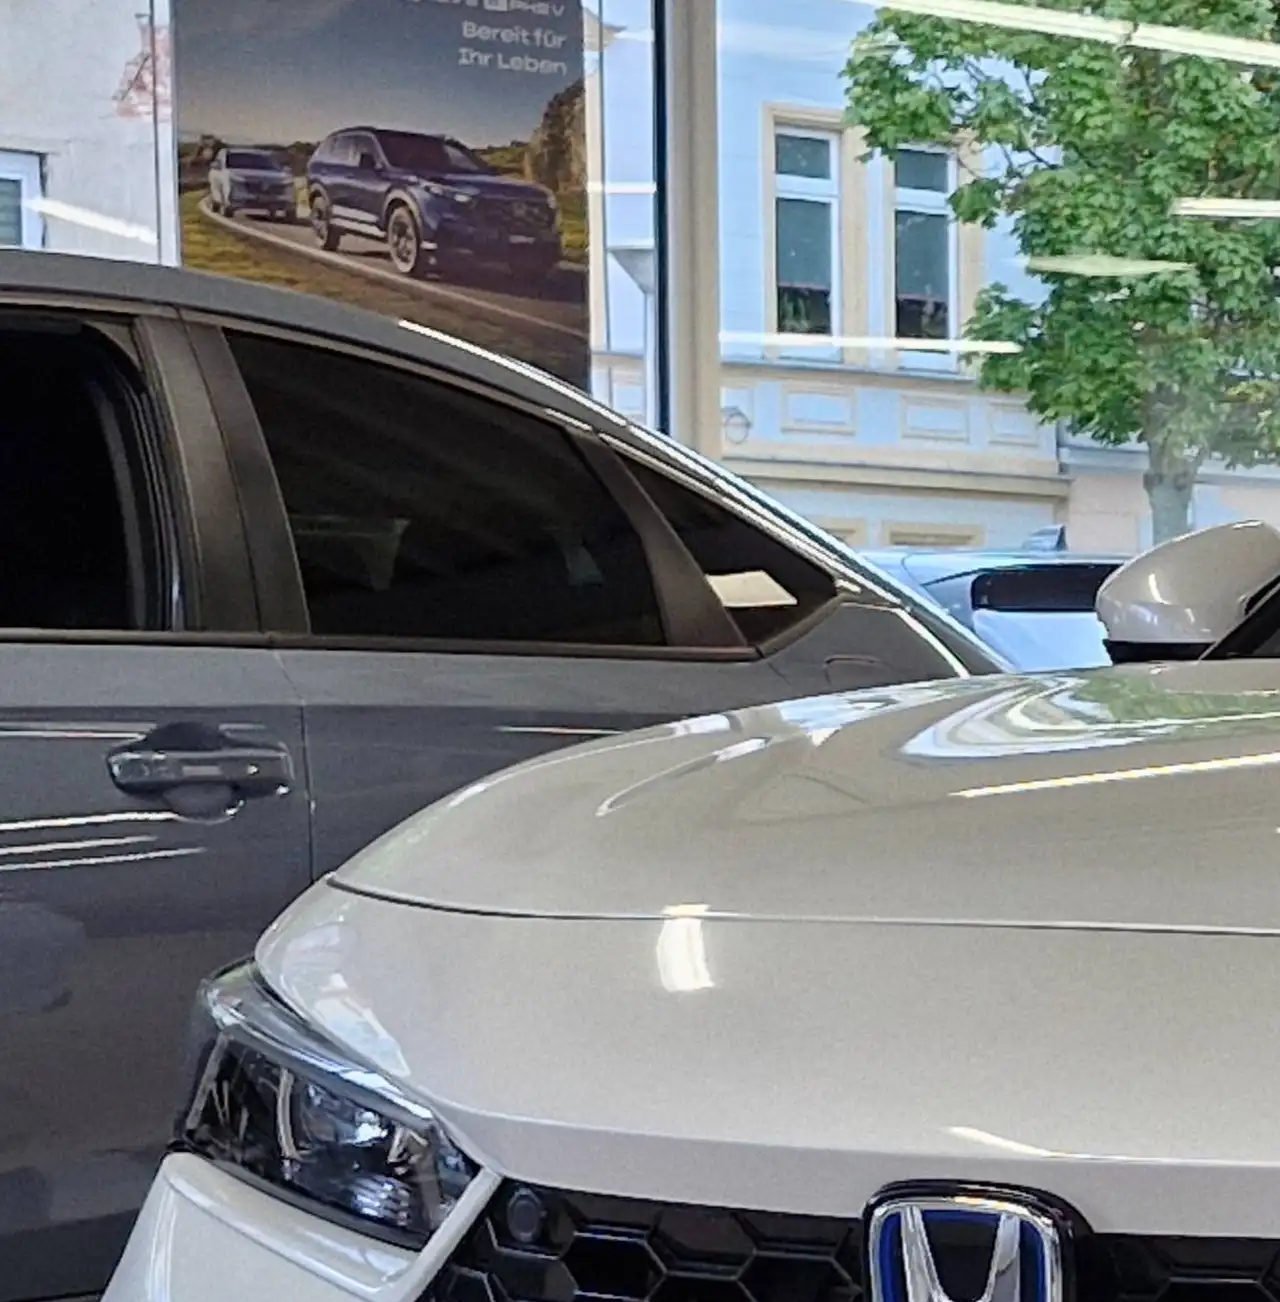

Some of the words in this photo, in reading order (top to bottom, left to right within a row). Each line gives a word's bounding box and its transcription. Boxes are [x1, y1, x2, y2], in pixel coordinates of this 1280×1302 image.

[462, 20, 531, 46] Bereit
[535, 27, 567, 49] für
[458, 48, 493, 67] Ihr
[498, 53, 567, 77] Leben
